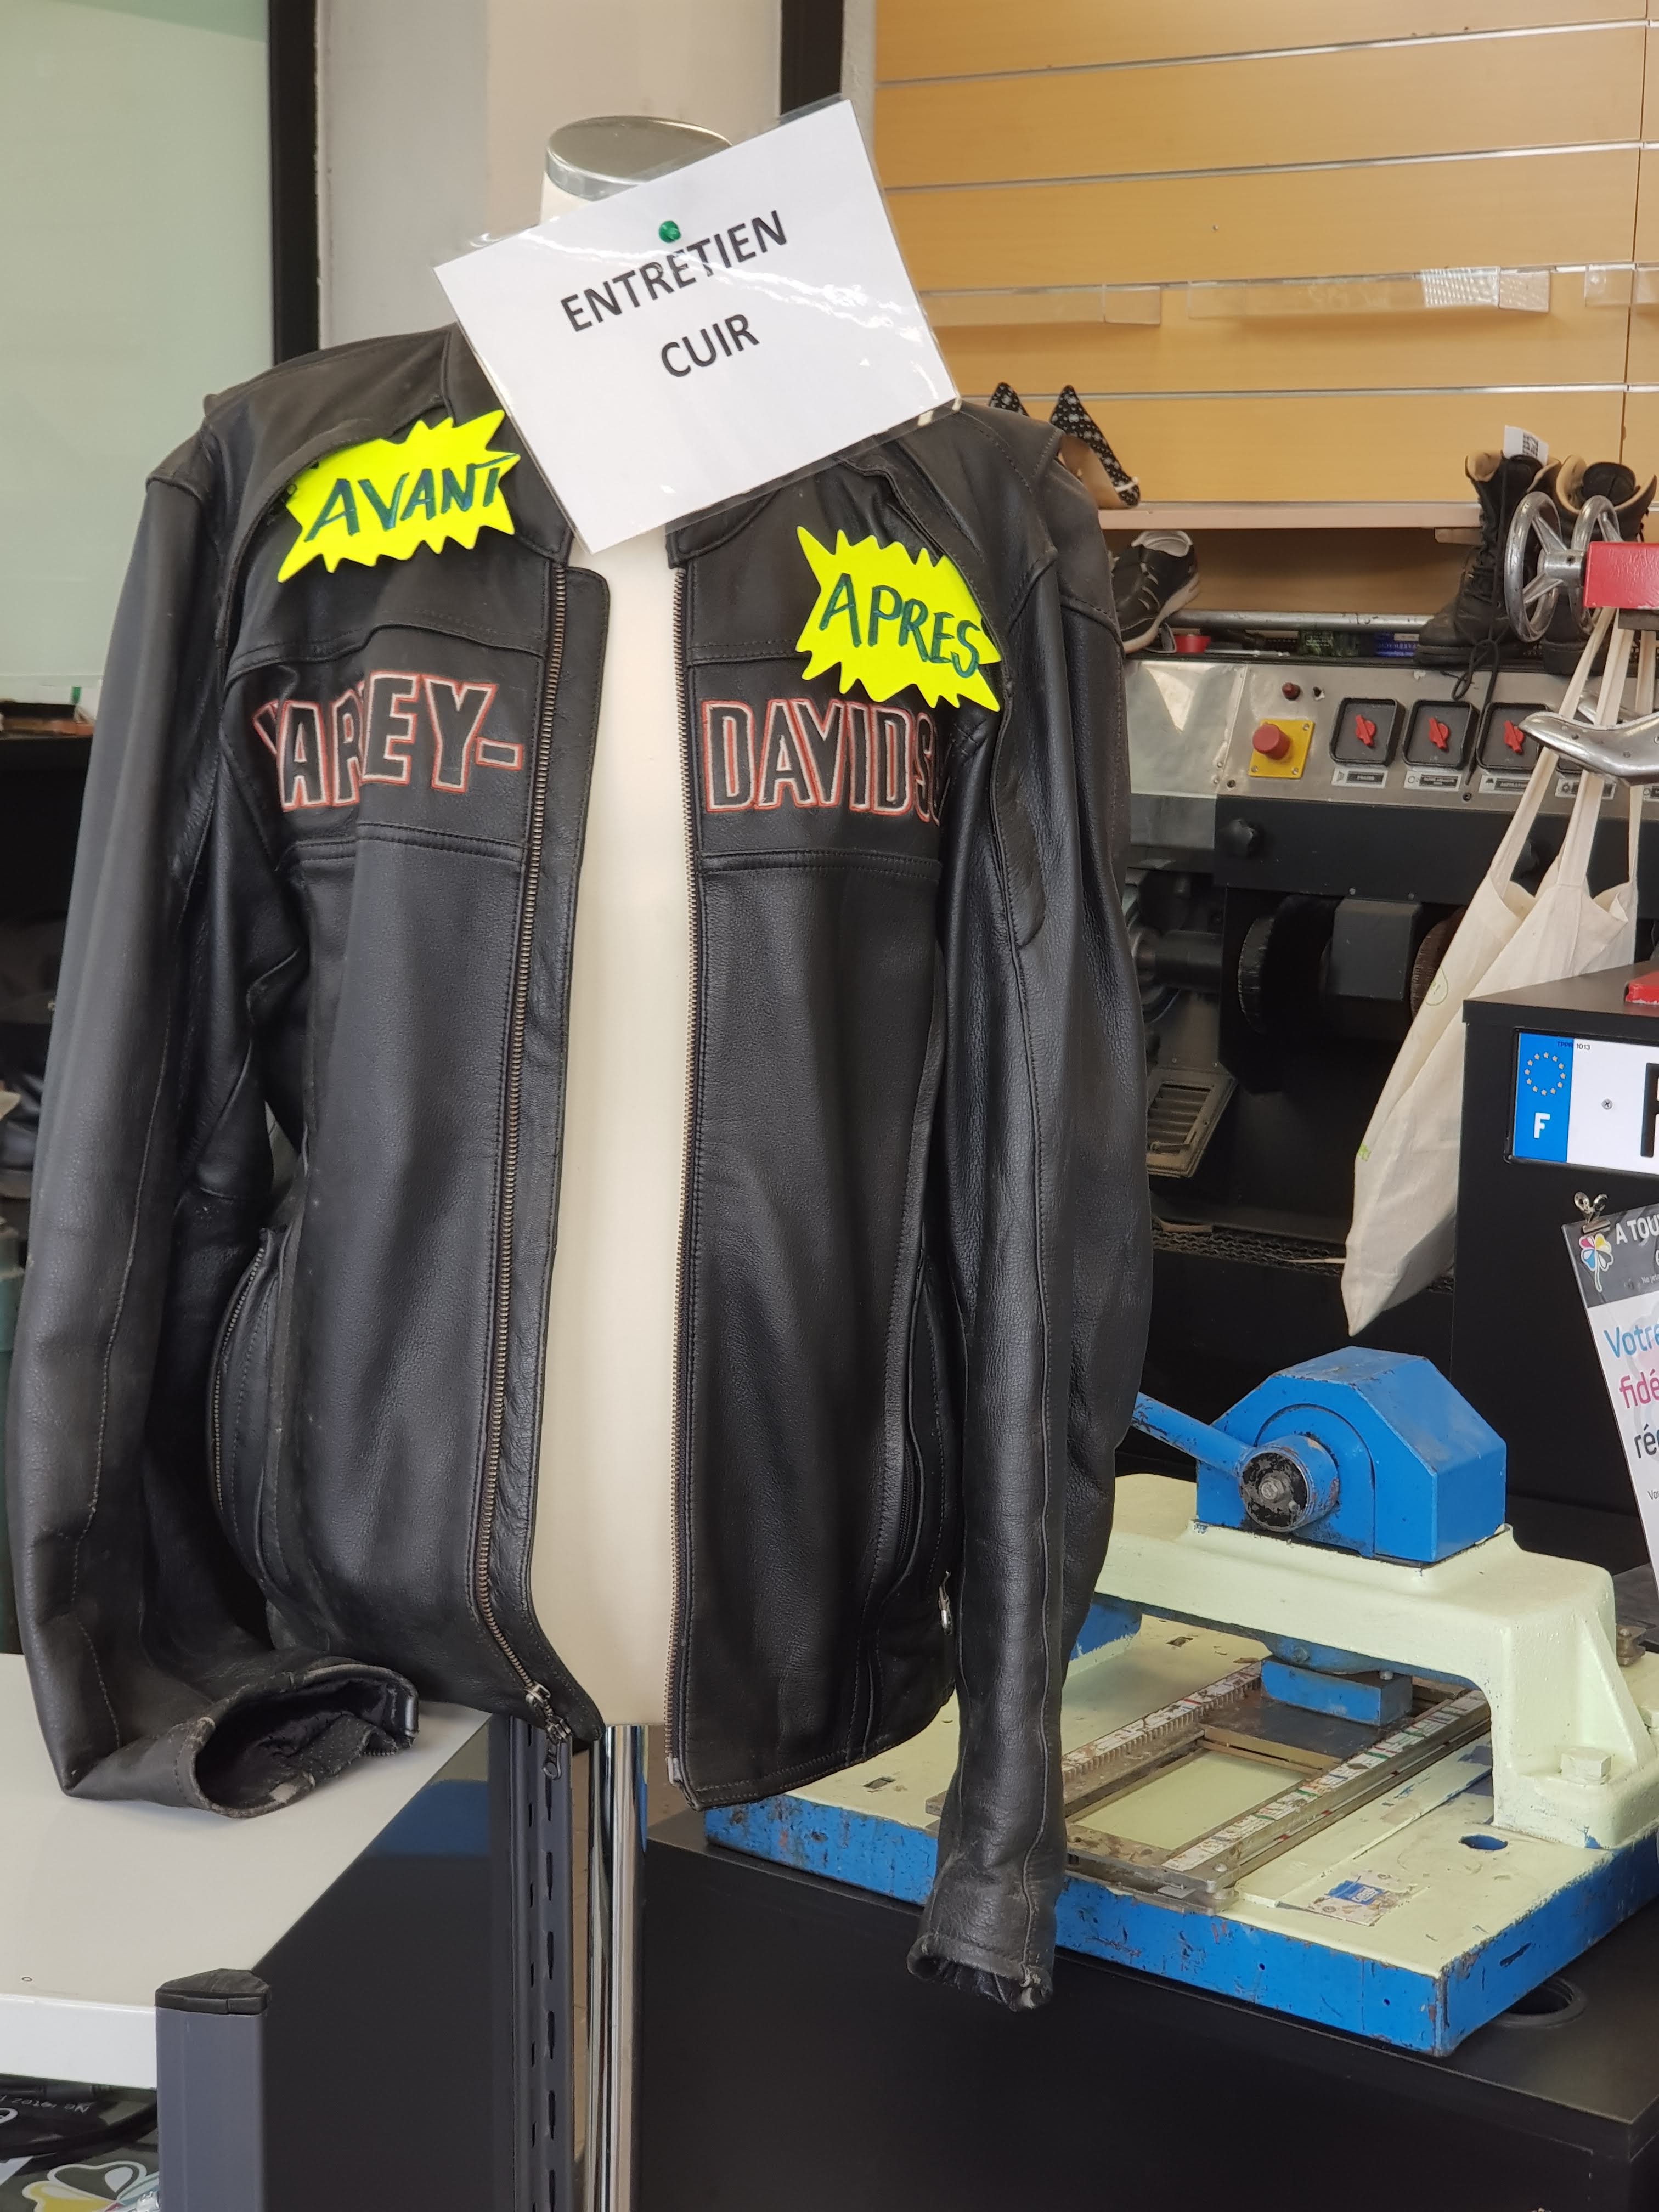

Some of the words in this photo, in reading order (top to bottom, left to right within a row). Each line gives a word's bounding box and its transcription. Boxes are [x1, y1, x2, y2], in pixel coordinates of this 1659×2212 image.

[560, 209, 788, 332] ENTRETIEN
[660, 313, 760, 377] CUIR
[304, 454, 518, 543] AVANT
[818, 573, 981, 679] APRES
[253, 670, 524, 812] AREY-
[701, 698, 940, 827] DAVIDS
[1534, 1112, 1550, 1139] F
[1616, 1222, 1628, 1245] A
[1626, 1214, 1659, 1241] TOU
[1634, 1423, 1659, 1459] ré
[1647, 1489, 1659, 1500] Vo
